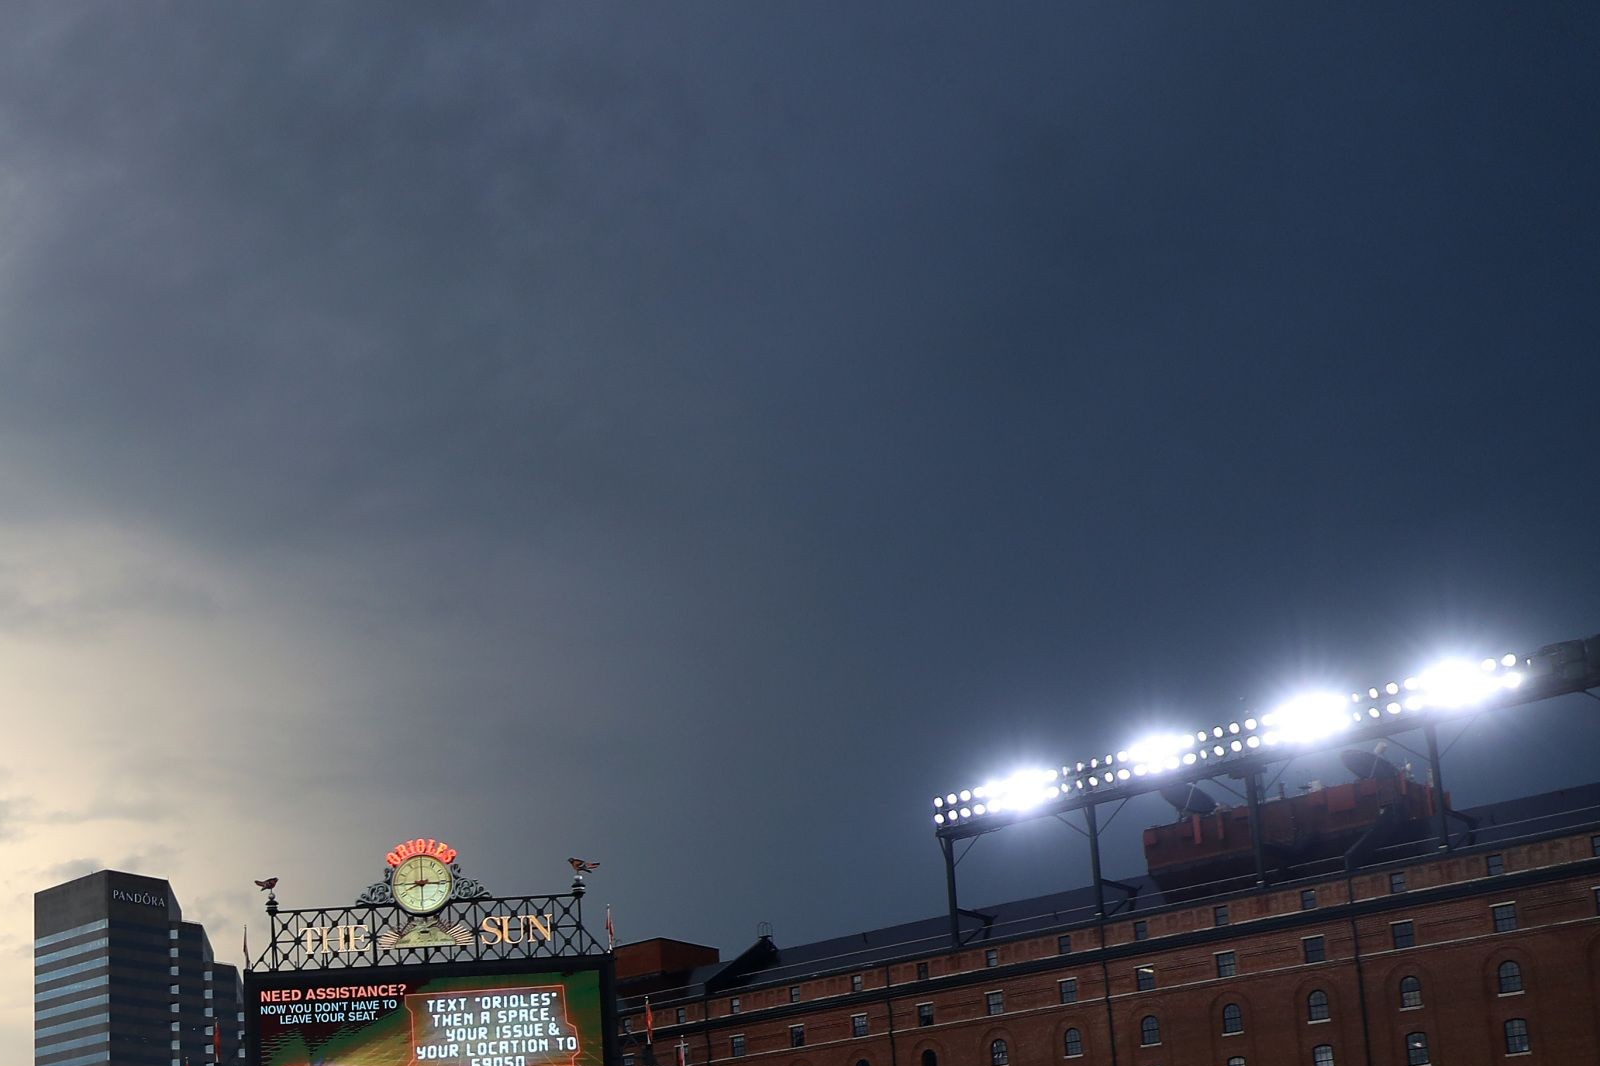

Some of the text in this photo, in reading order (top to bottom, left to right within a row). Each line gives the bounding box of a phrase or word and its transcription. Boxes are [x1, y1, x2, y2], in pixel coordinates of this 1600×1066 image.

[386, 838, 457, 867] ORIOLES
[299, 914, 553, 955] THE SUN
[260, 984, 407, 1002] NEED ASSISTANCE?
[427, 992, 557, 1012] TEXT "ORIOLES"
[260, 999, 397, 1015] NOW YOU DON'T HAVE TO
[280, 1011, 378, 1025] LEAVE YOUR SEAT.
[432, 1013, 474, 1027] THEN
[481, 1011, 490, 1024] A
[446, 1022, 560, 1042] YOUR ISSUE &
[416, 1037, 577, 1059] YOUR LOCATION TO
